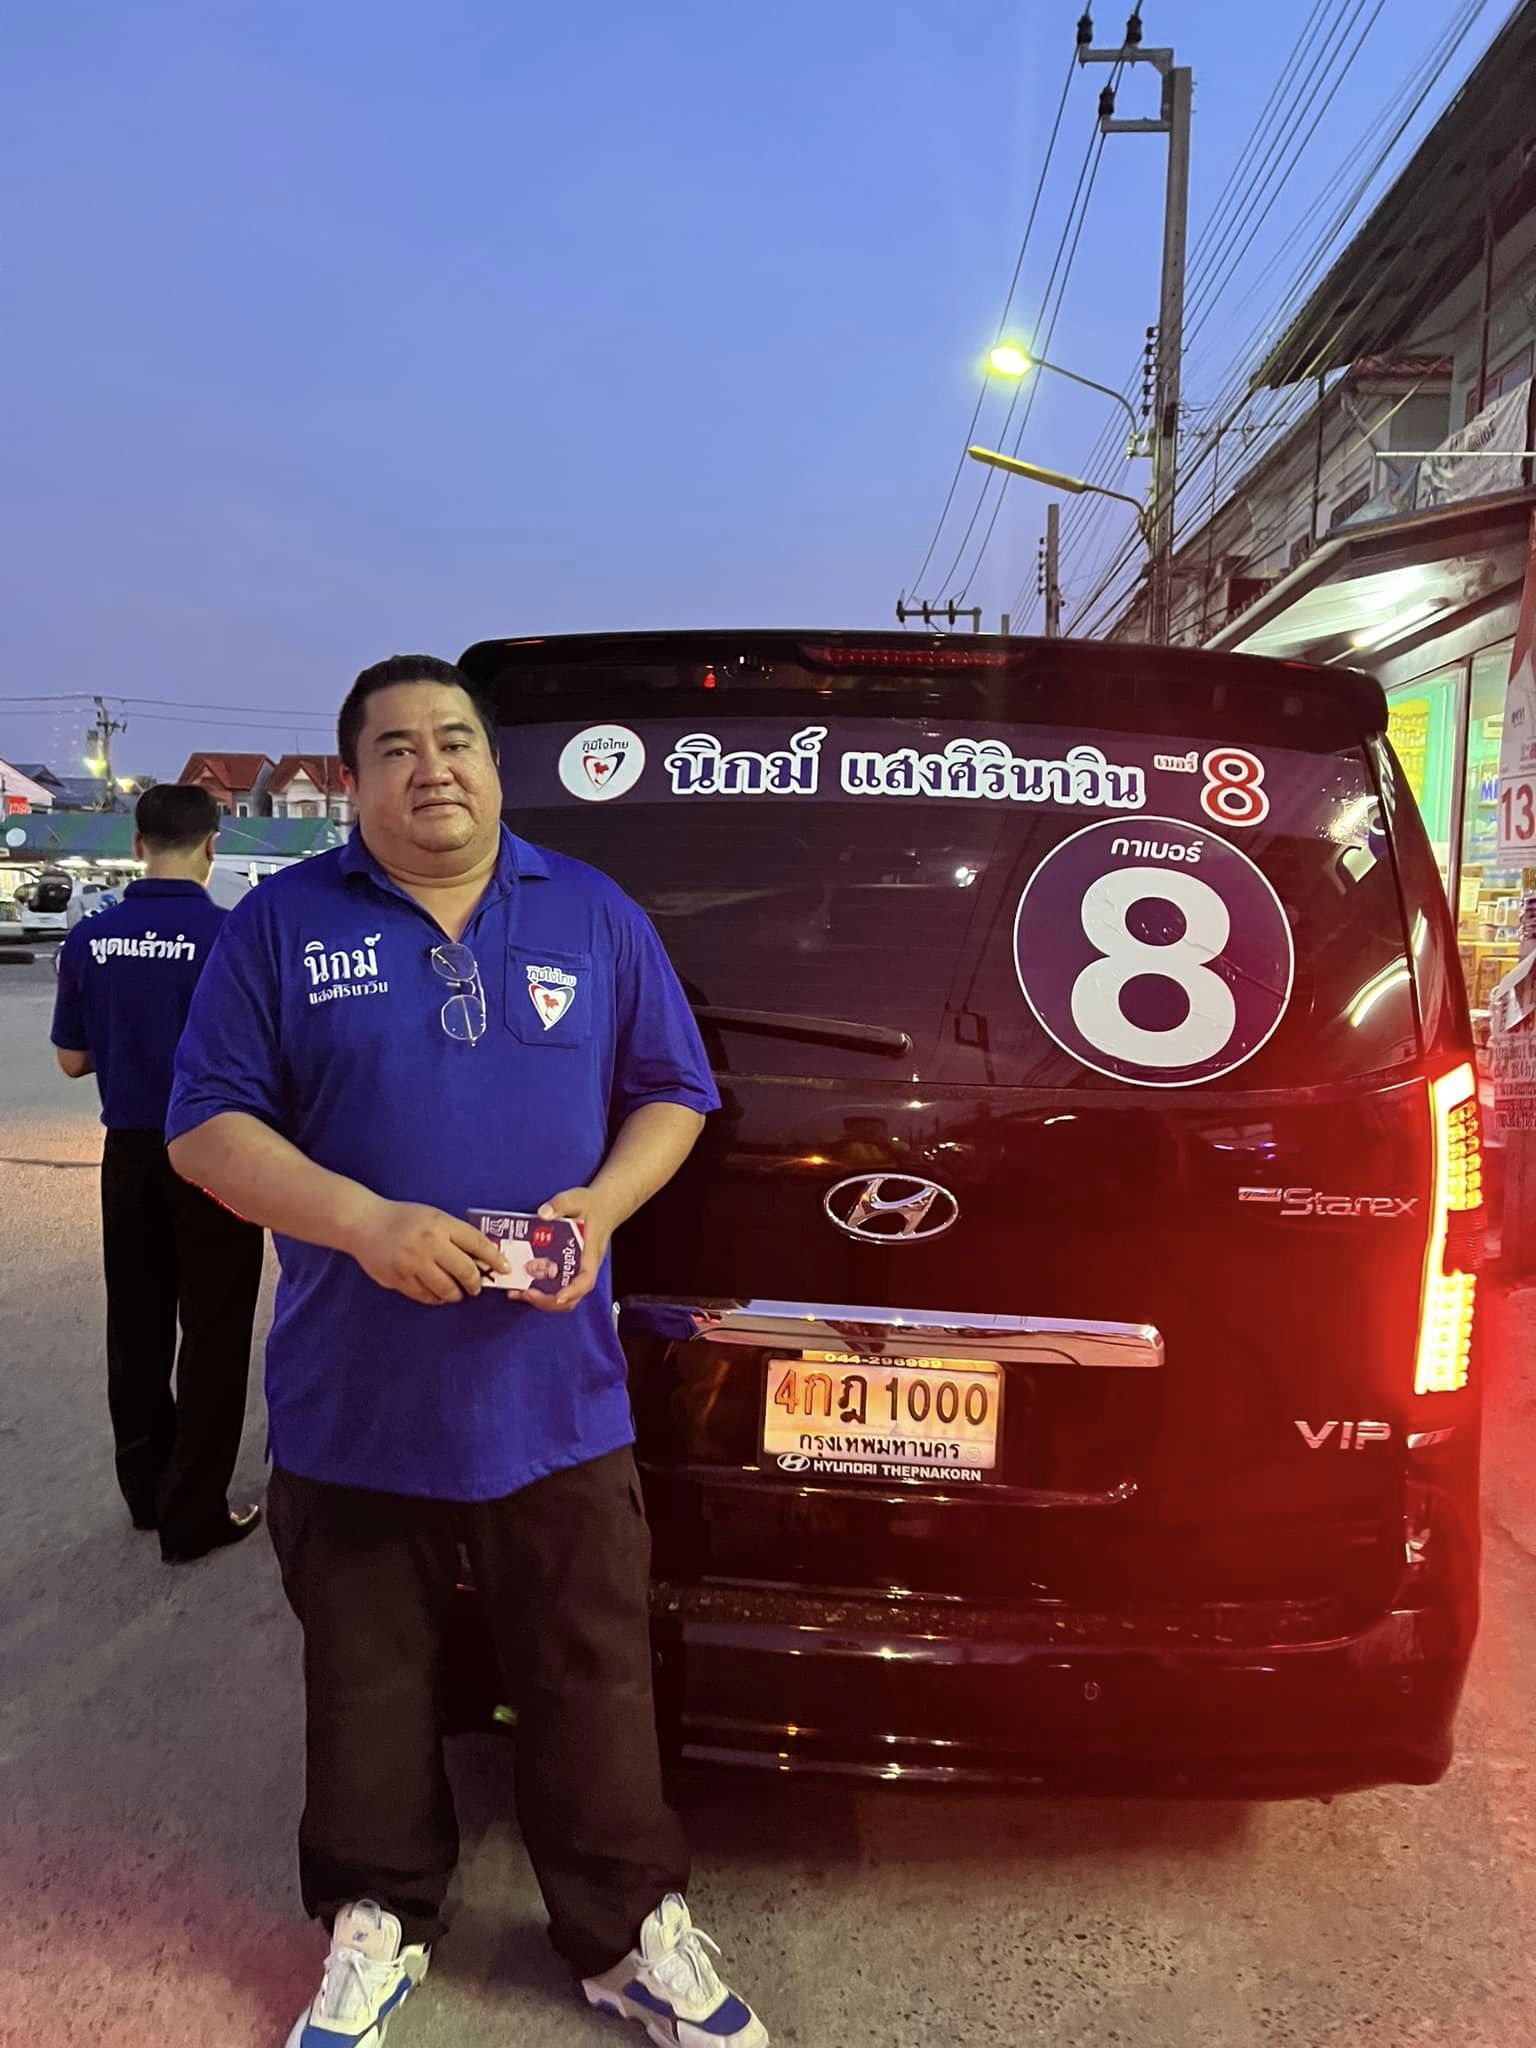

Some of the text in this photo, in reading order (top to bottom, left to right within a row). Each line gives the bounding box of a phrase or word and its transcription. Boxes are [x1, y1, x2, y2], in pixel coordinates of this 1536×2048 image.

[582, 737, 629, 753] ภูมิใจไทย
[665, 727, 1146, 808] นิกม์ แสงศิรินาวิน
[1154, 748, 1269, 826] เบอร์ 8
[1110, 837, 1204, 863] กาเบอร์
[89, 931, 196, 965] พูดแล้วทำ
[304, 933, 381, 985] นิกม์
[528, 966, 576, 985] ภูมิใจไทย
[1071, 866, 1236, 1067] 8
[309, 979, 388, 1005] แสงศิรินาวิน
[1280, 1187, 1419, 1218] Starex
[774, 1368, 989, 1426] 4กฎ 1000
[799, 1432, 960, 1460] กรุงเทพมหานคร
[1294, 1420, 1392, 1450] VIP
[813, 1459, 982, 1482] HYUNDAI THEPNAKORN
